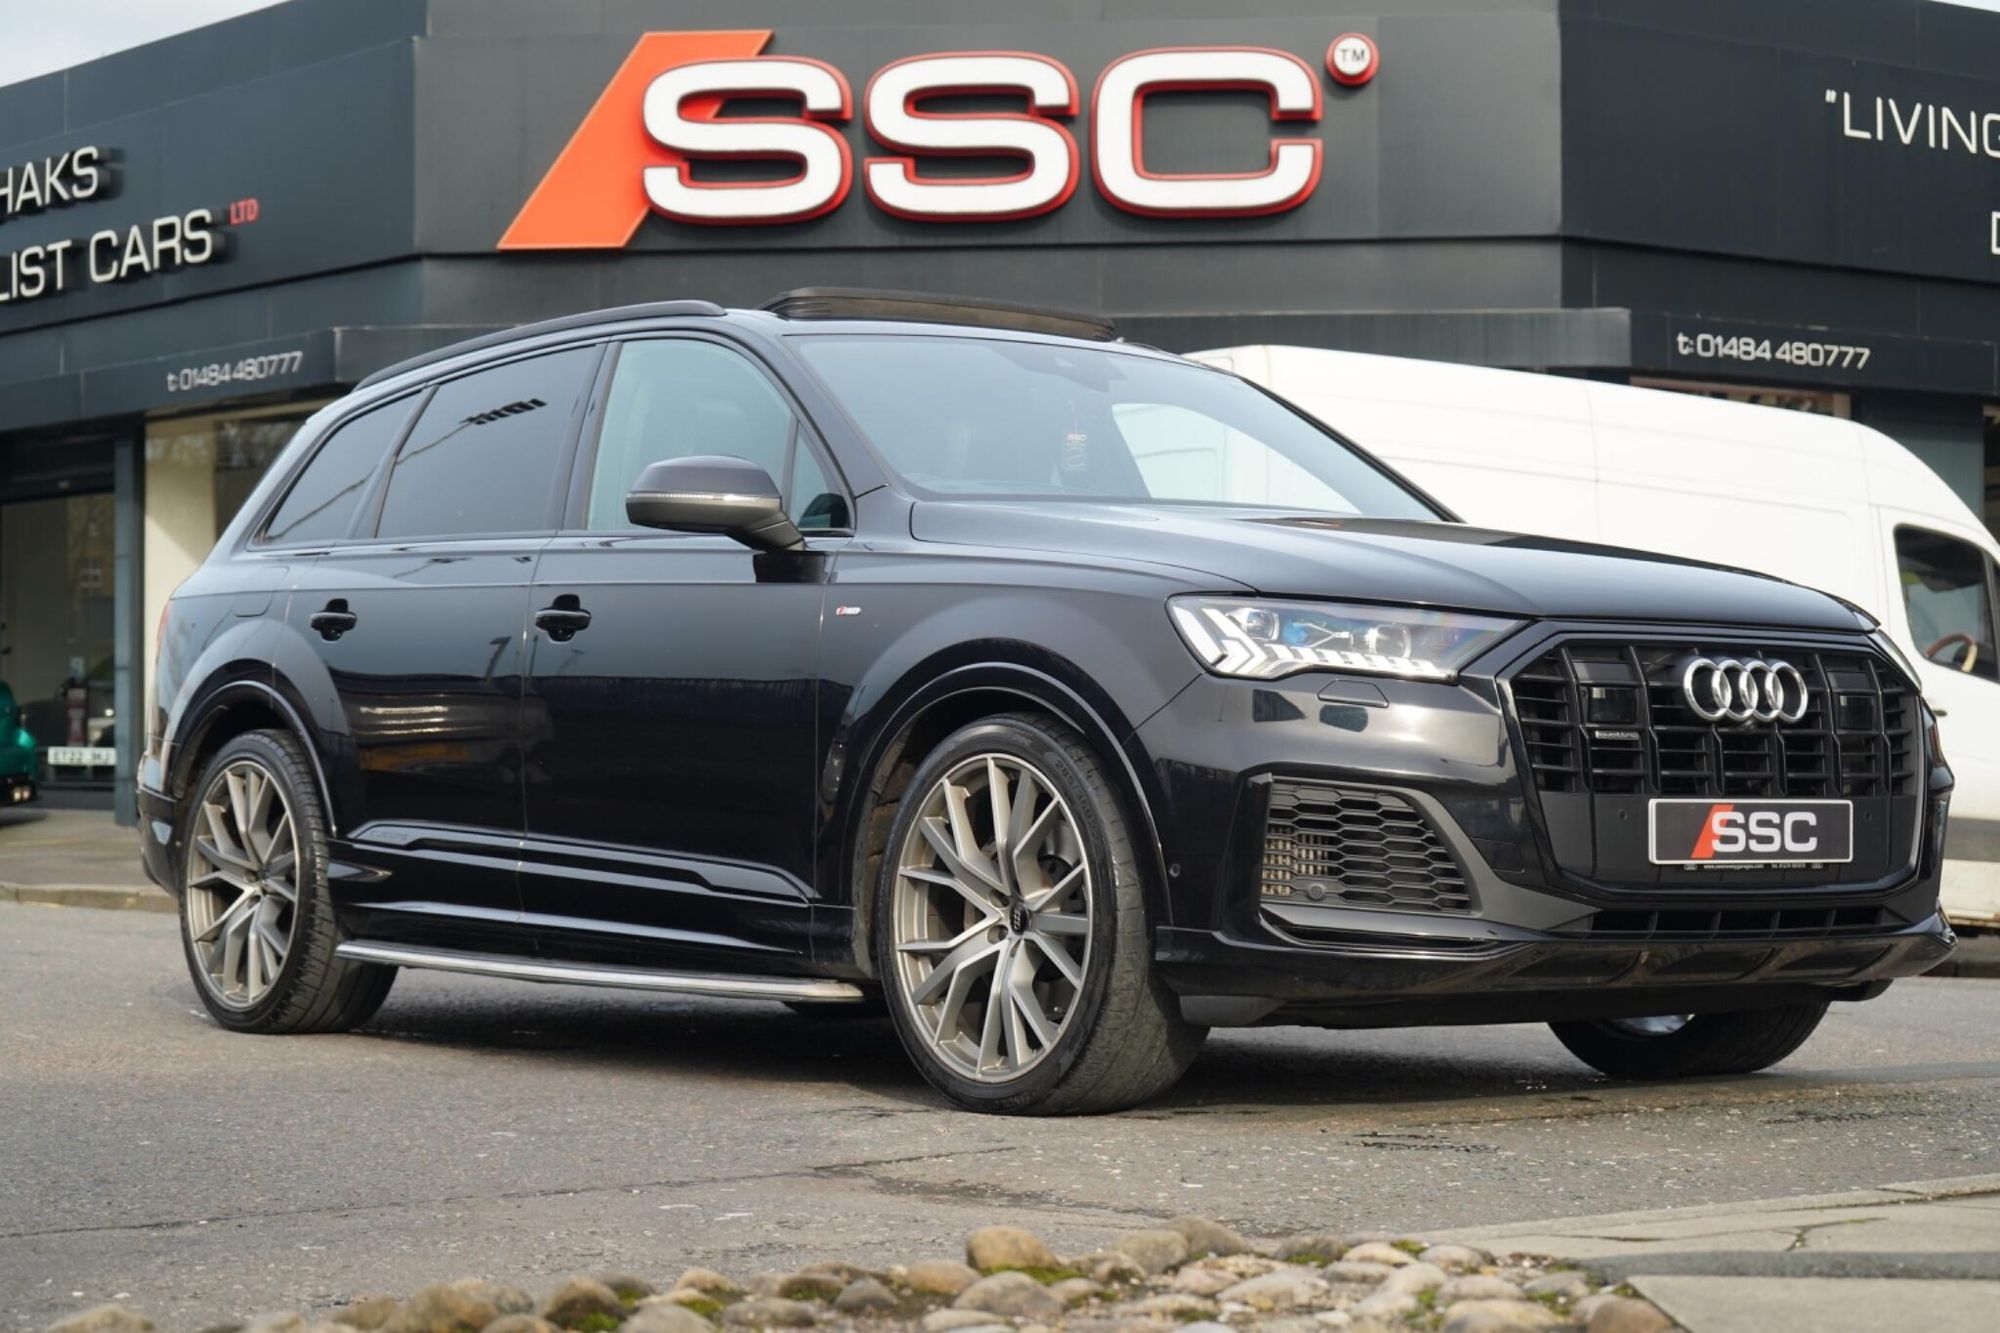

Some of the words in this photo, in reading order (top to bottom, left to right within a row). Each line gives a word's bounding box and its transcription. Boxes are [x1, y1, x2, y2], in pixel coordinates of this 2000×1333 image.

[1339, 48, 1366, 62] TM
[644, 47, 1322, 224] SSC
[229, 198, 260, 225] LTD
[89, 209, 213, 282] CARS
[232, 350, 303, 381] 480777
[1775, 341, 1871, 370] 480777
[1711, 811, 1818, 853] SSC
